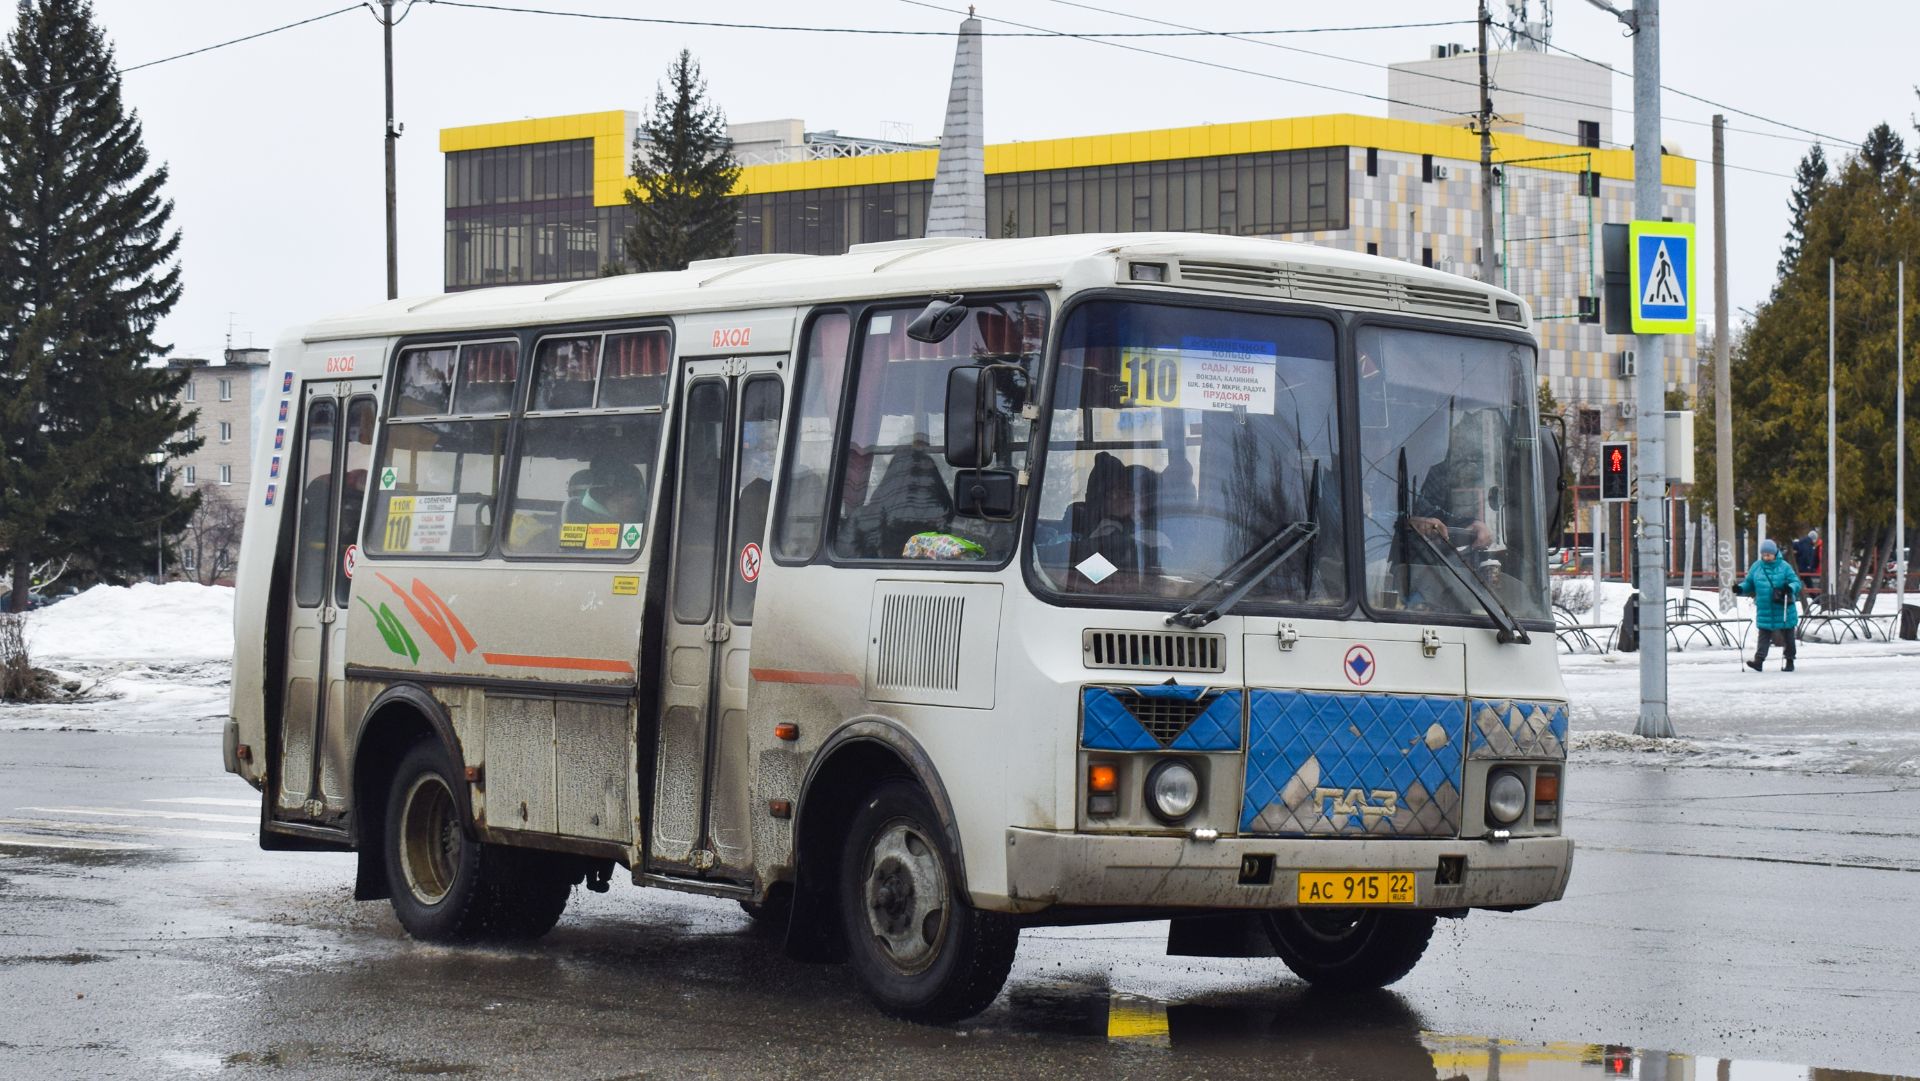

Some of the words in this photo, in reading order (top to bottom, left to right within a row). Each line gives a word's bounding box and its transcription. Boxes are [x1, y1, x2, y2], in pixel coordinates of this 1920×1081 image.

[712, 327, 751, 348] ВХОД
[327, 355, 355, 372] ВХОД
[1212, 351, 1251, 361] КОЛЬЦО
[1201, 362, 1230, 374] САДЫ,
[1232, 364, 1254, 374] ЖБИ
[1125, 356, 1178, 403] 110
[1195, 374, 1223, 383] ВОКЗАЛ,
[1224, 376, 1259, 384] КАЛИНИНА
[1203, 390, 1251, 402] ПРУДСКАЯ
[1243, 385, 1267, 393] РАДУГА
[387, 515, 411, 549] 110
[1313, 787, 1398, 816] ПАЗ
[1309, 881, 1333, 900] АС
[1343, 876, 1379, 899] 915
[1390, 875, 1408, 892] 22
